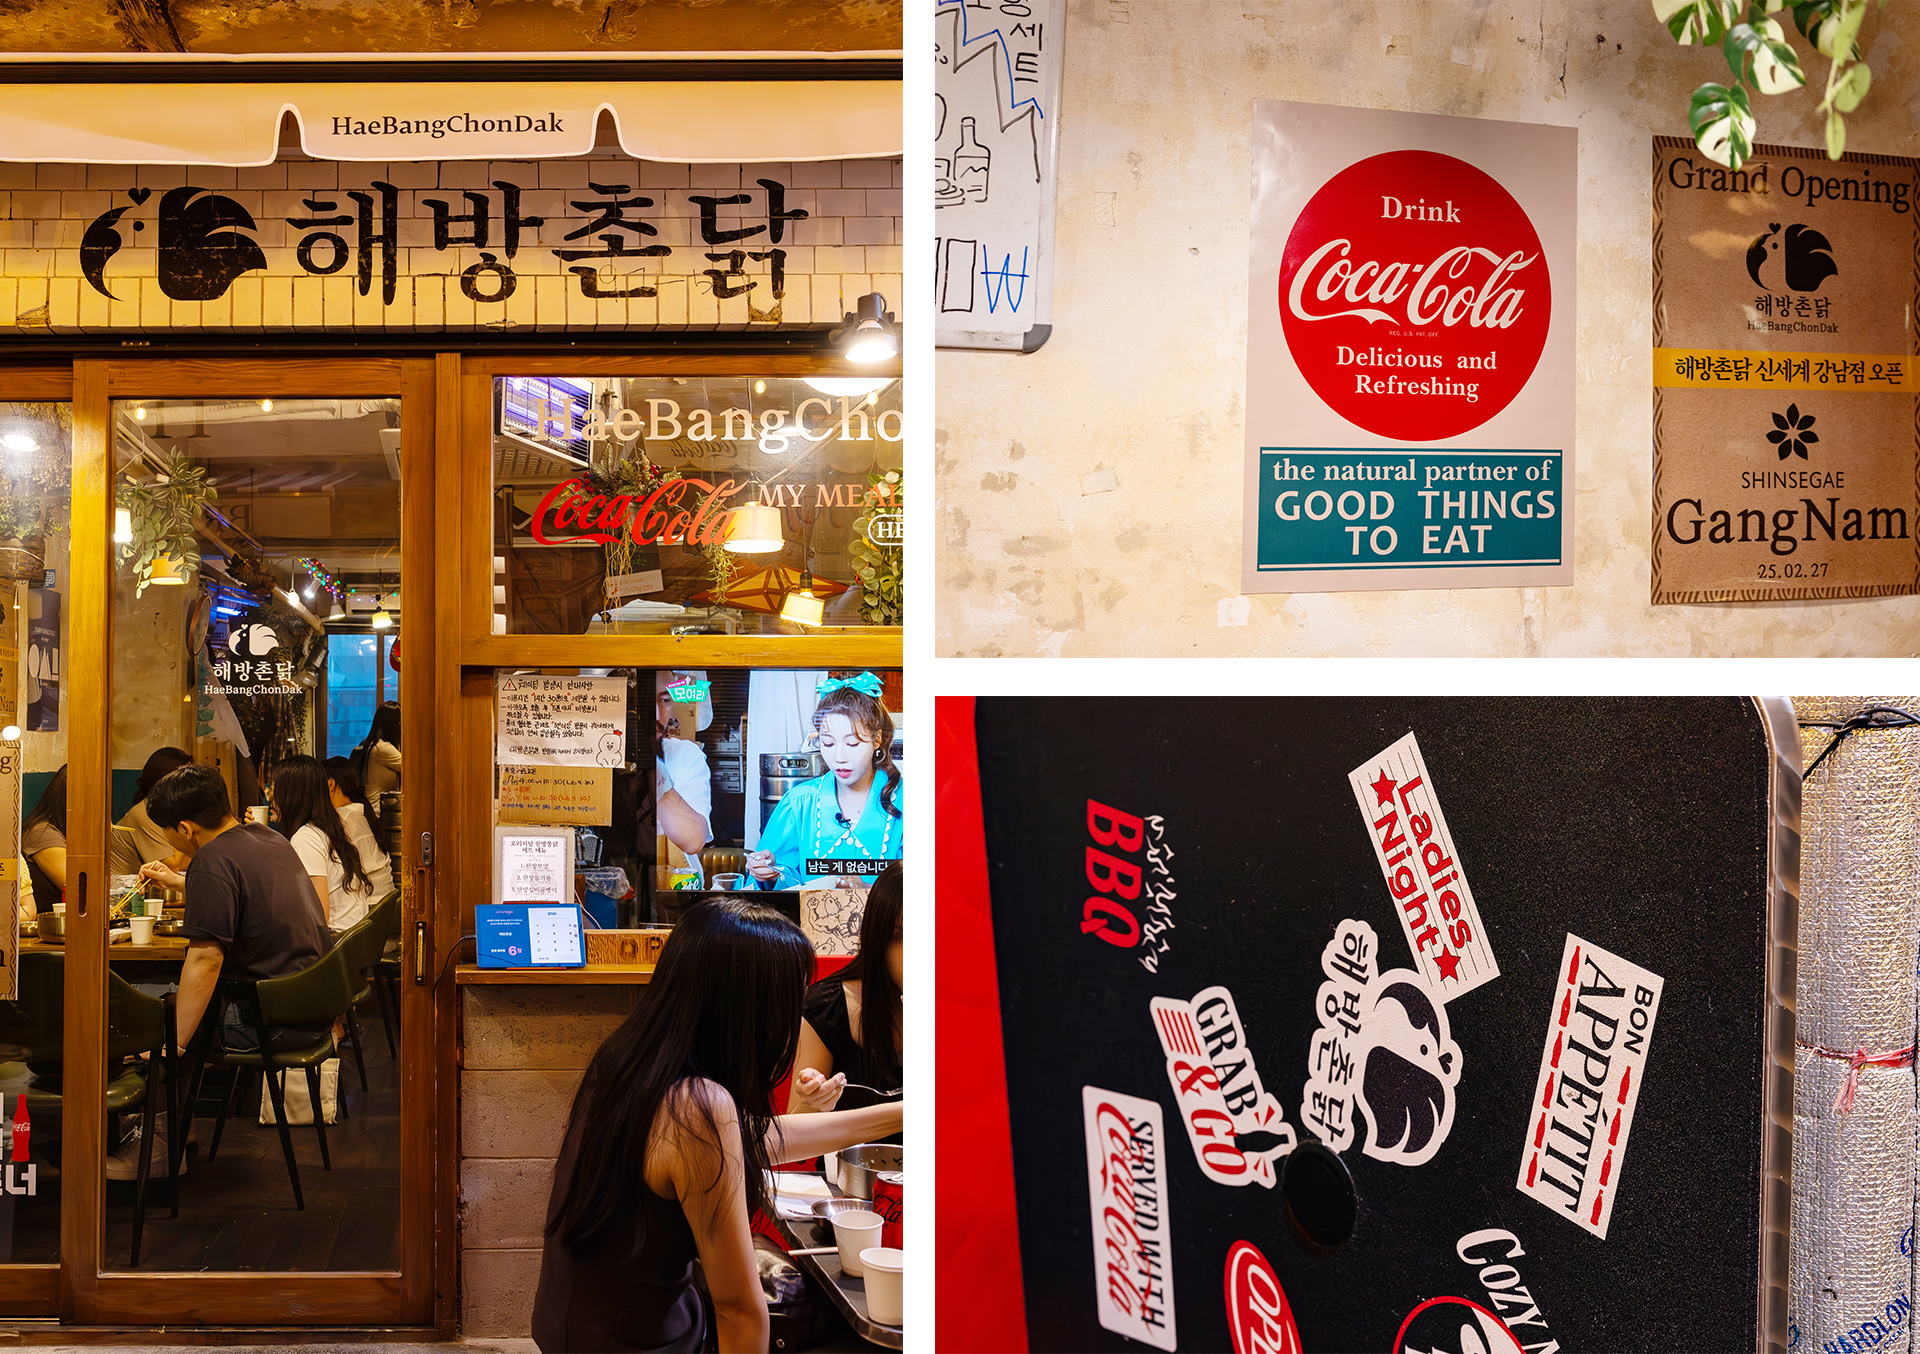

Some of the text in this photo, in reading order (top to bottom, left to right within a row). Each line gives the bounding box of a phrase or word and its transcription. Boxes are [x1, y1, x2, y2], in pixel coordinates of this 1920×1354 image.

[332, 112, 564, 138] HaeBangChonDak
[1668, 157, 1911, 214] Grand Opening
[1381, 195, 1461, 224] Drink
[285, 179, 810, 306] 해방촌닭
[1289, 238, 1540, 330] Coca-Cola
[1754, 294, 1832, 318] 해방촌닭
[1747, 320, 1839, 334] HaeBangChonDak
[1336, 346, 1497, 370] Delicious and
[1674, 356, 1904, 385] 해방촌닭 신세계 강남점 오픈
[1355, 374, 1480, 403] Refreshing
[1273, 458, 1553, 489] the natural partner of
[1741, 471, 1845, 489] SHINSEGAE
[757, 484, 806, 507] MY
[1274, 490, 1556, 521] GOOD THINGS
[531, 477, 751, 547] Coca-Cola
[1666, 498, 1911, 556] GangNam
[1344, 525, 1493, 556] TO EAT
[1757, 563, 1829, 579] 25.02.27
[212, 660, 296, 683] 해방촌닭
[204, 684, 303, 697] HaeBangChonDak
[674, 688, 705, 700] 모여라
[808, 861, 830, 873] 남는
[832, 861, 843, 873] 게
[1081, 798, 1145, 949] BBQ
[1396, 775, 1473, 951] Ladies
[1373, 814, 1439, 954] Night
[1624, 984, 1654, 1056] BON
[1310, 930, 1370, 1144] 해방촌닭
[1195, 996, 1258, 1117] GRAB
[1540, 953, 1627, 1214] APPÉTIT
[1174, 1060, 1248, 1177] & GO
[1127, 1116, 1165, 1330] SERVED WITH
